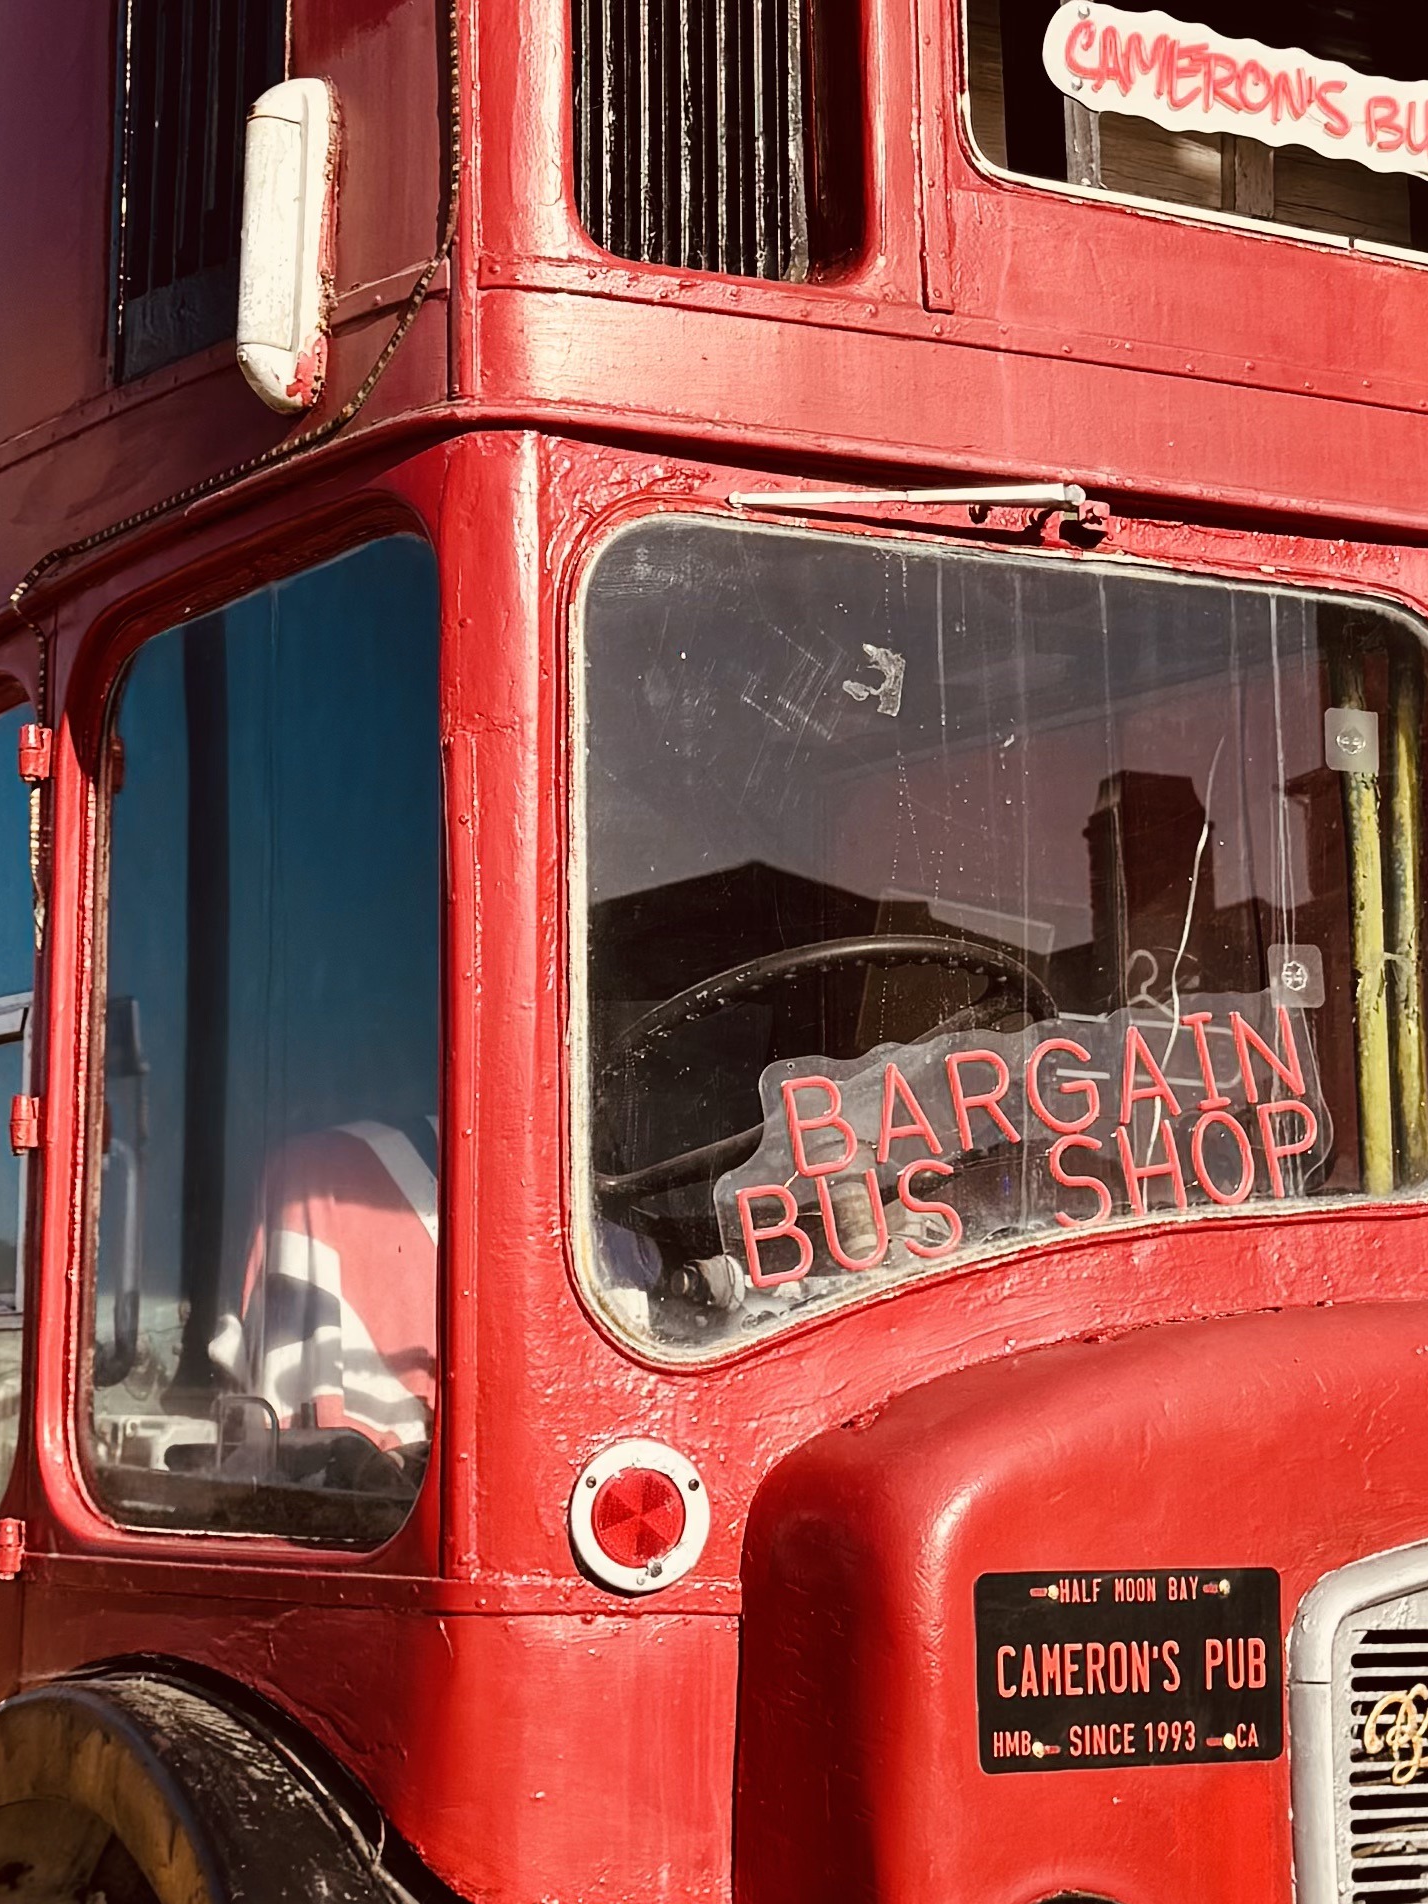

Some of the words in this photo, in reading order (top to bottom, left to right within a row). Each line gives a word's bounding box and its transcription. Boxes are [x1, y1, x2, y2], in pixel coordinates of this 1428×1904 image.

[1065, 19, 1352, 139] CAMERON'S
[780, 1003, 1307, 1177] BARGAIN
[735, 1159, 963, 1289] BUS
[1046, 1099, 1319, 1227] SHOP
[1059, 1578, 1102, 1603] HALF
[1115, 1577, 1156, 1602] MOON
[1168, 1576, 1199, 1601] BAY
[997, 1640, 1181, 1699] CAMERON'S
[1205, 1637, 1266, 1690] PUB
[993, 1730, 1031, 1758] HMB
[1069, 1723, 1136, 1757] SINCE
[1144, 1720, 1196, 1753] 1993
[1236, 1722, 1259, 1748] CA
